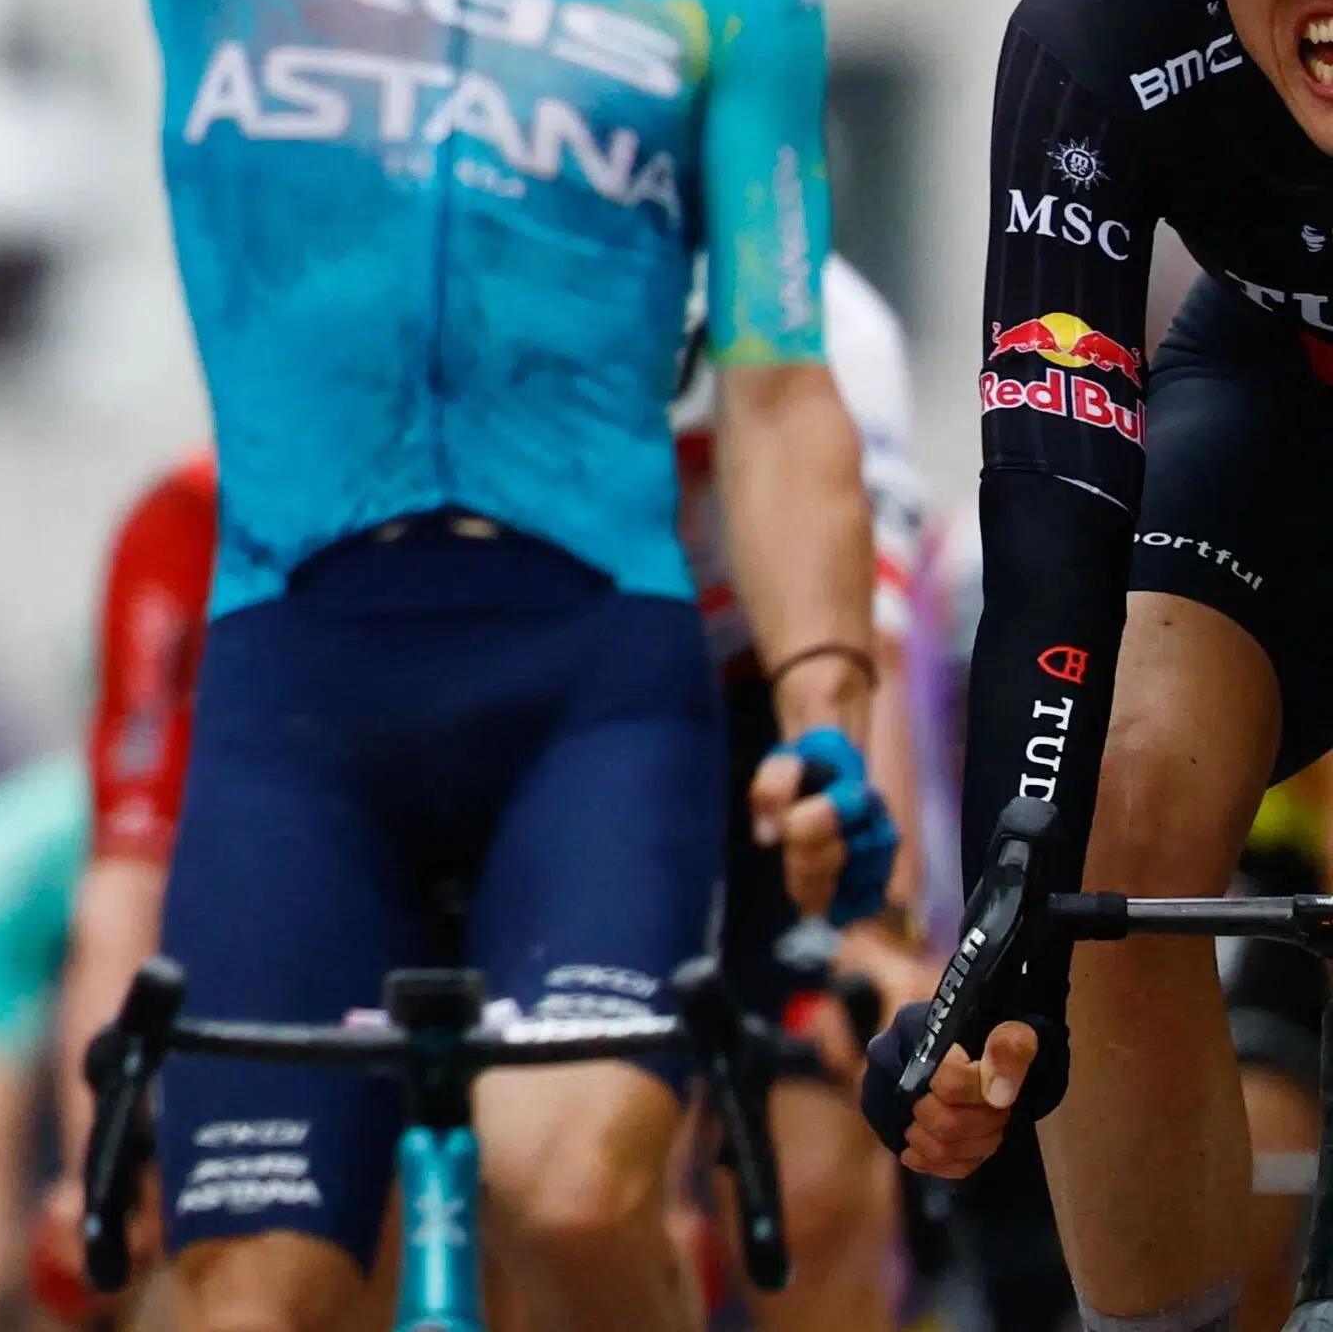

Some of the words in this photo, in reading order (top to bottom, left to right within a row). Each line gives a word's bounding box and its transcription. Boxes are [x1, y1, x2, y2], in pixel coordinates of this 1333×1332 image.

[1130, 33, 1243, 111] BMC
[184, 40, 681, 228] ASTANA
[1005, 189, 1131, 261] MSC
[980, 368, 1067, 416] Red
[1070, 375, 1146, 451] Bul
[1133, 532, 1264, 590] ortful
[1019, 696, 1074, 803] TUD
